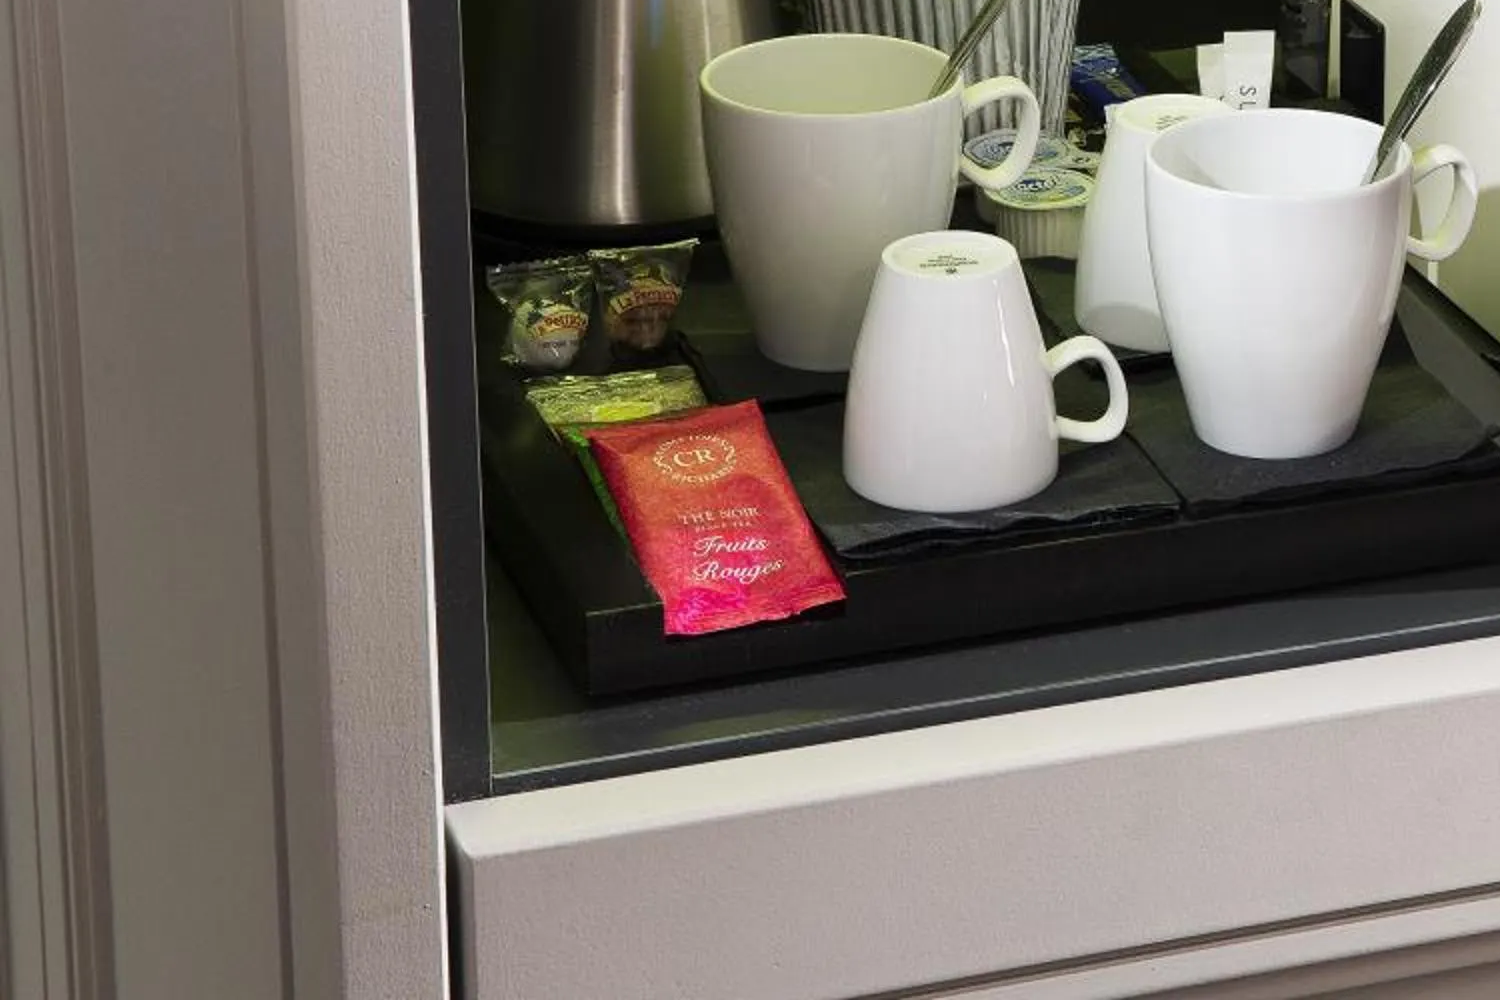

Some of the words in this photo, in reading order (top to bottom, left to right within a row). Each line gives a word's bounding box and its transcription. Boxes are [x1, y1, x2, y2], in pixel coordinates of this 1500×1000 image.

[673, 449, 716, 467] CR
[720, 505, 760, 519] NOIR
[693, 535, 768, 557] Fruits
[693, 559, 784, 584] Rouges
